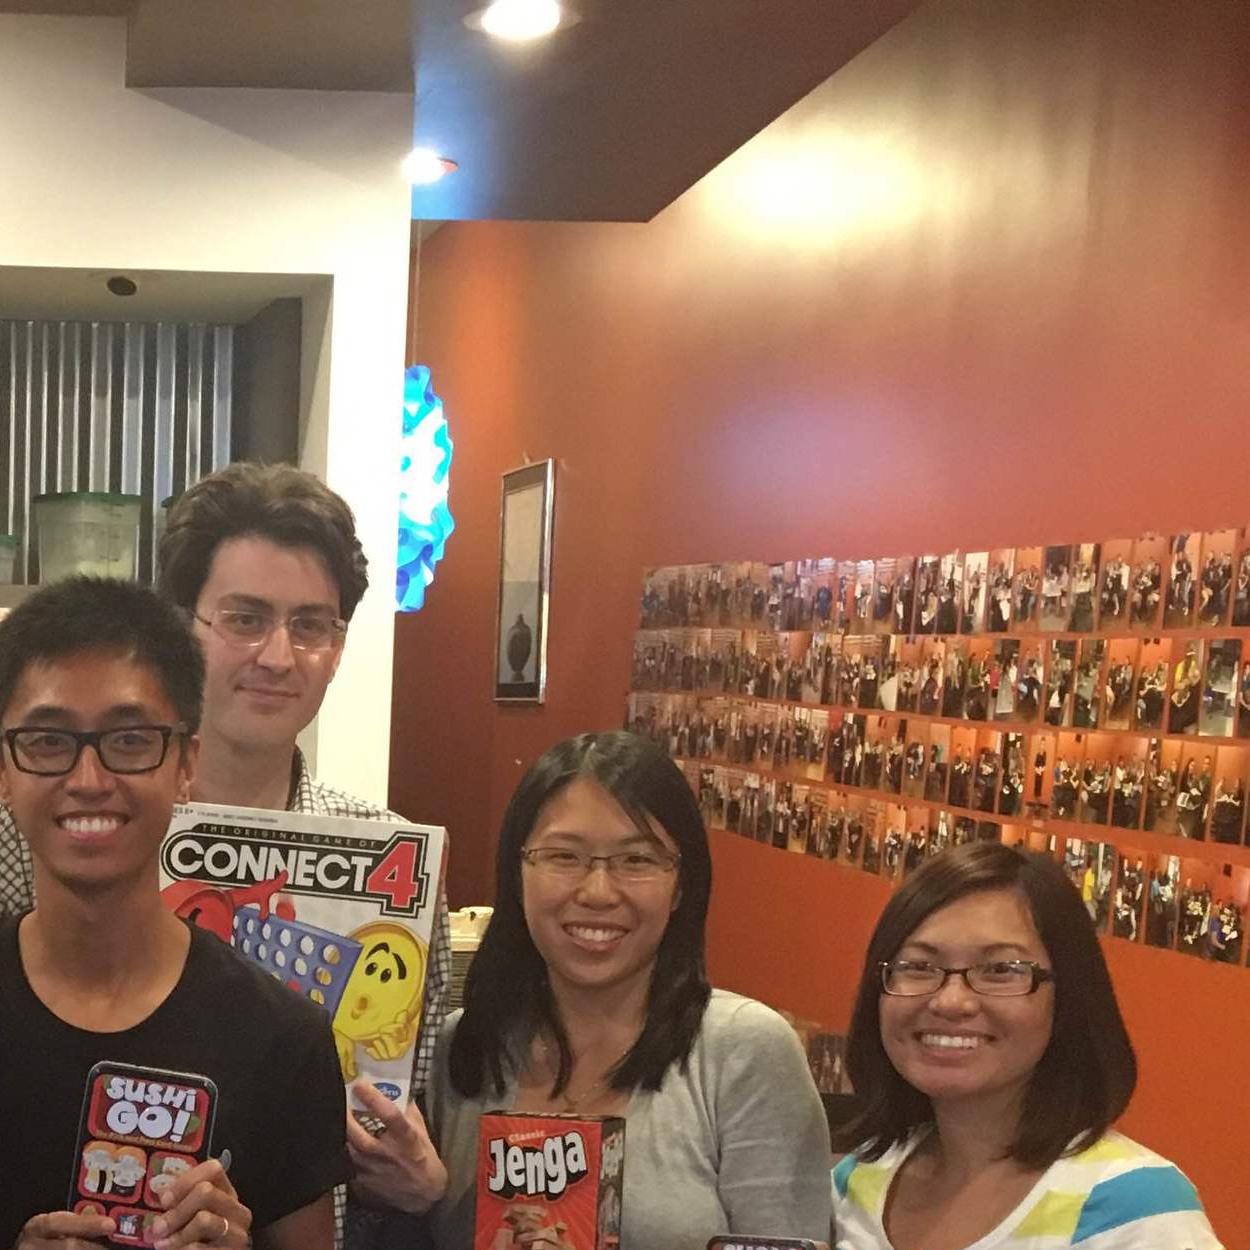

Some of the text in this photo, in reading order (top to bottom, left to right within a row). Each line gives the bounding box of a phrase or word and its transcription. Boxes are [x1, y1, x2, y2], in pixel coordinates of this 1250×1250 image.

[202, 824, 376, 849] THE ORIGINAL GAME OF
[170, 839, 418, 909] CONNECT 4
[106, 1100, 191, 1143] GO!
[509, 1130, 546, 1143] Classic
[489, 1132, 587, 1194] Jenga
